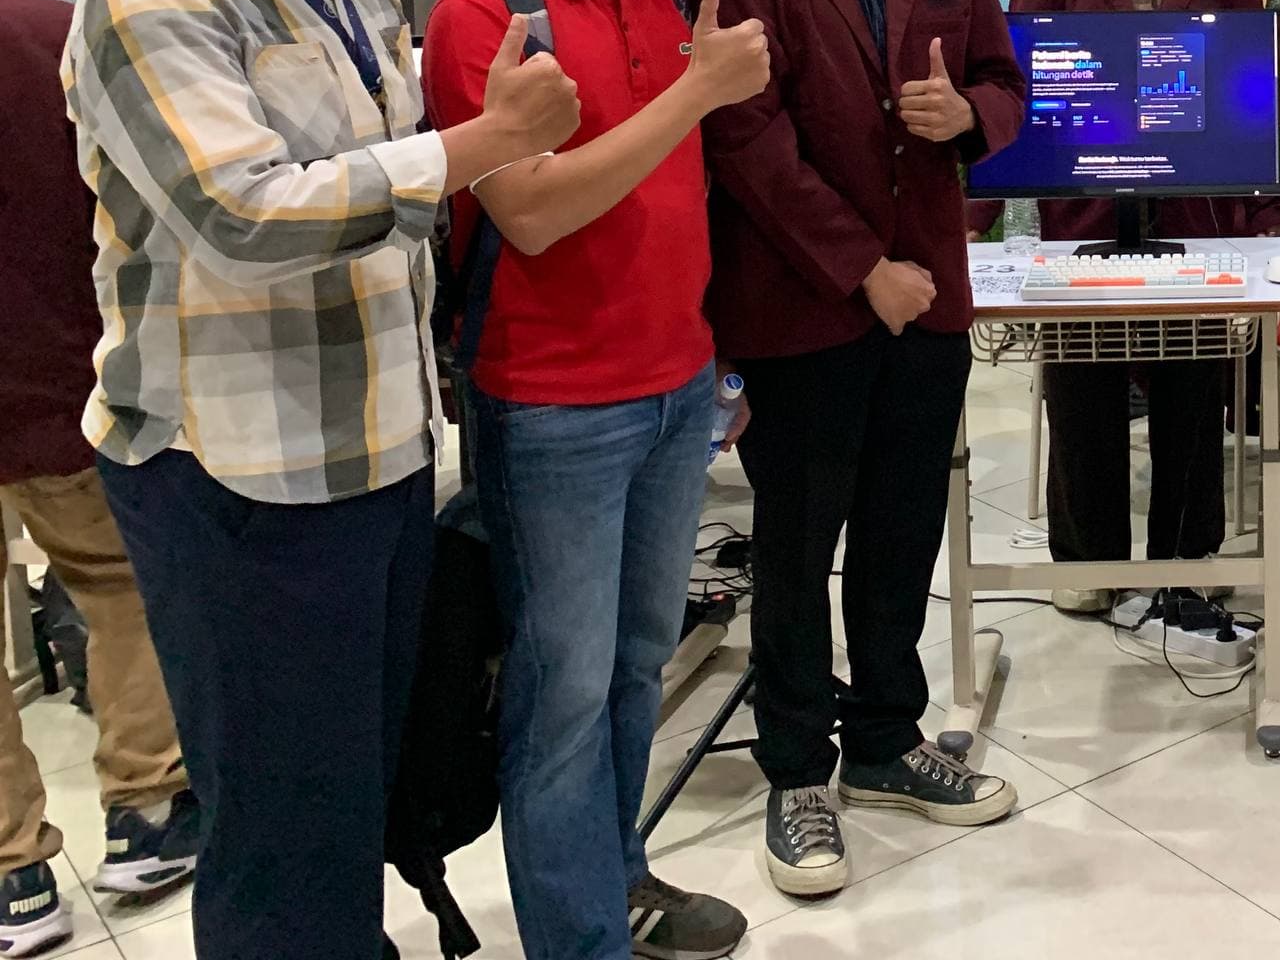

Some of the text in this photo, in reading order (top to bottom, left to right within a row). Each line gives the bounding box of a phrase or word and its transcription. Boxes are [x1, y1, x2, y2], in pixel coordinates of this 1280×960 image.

[1075, 60, 1102, 69] dalam
[1032, 70, 1094, 80] hitungan detik
[973, 264, 1015, 273] 23
